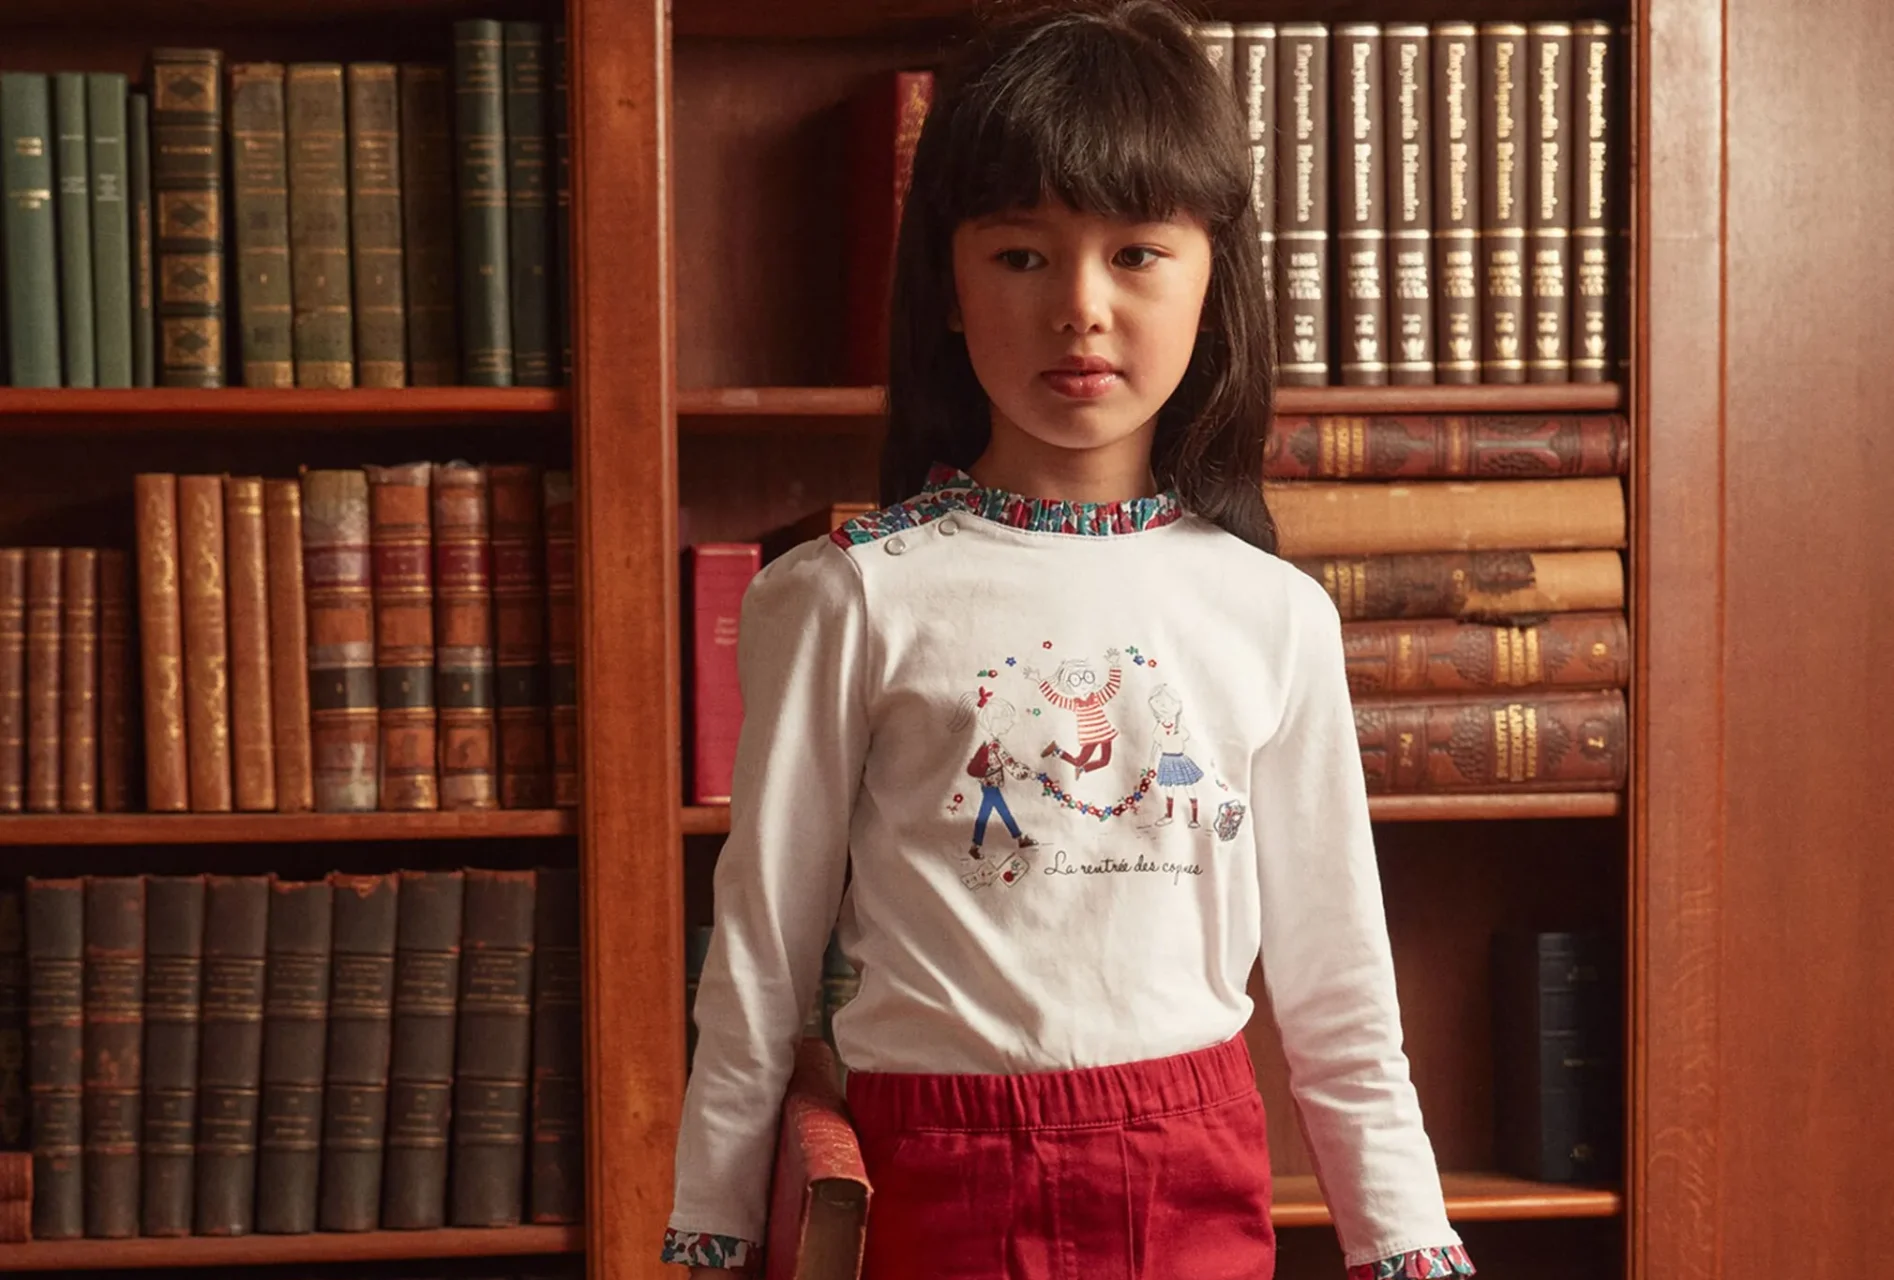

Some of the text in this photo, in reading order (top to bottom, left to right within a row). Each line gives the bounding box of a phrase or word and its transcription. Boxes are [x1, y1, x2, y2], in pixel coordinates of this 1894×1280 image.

[1588, 736, 1605, 749] 7
[1044, 850, 1078, 876] La
[1080, 858, 1131, 875] rentrée
[1134, 854, 1160, 873] des
